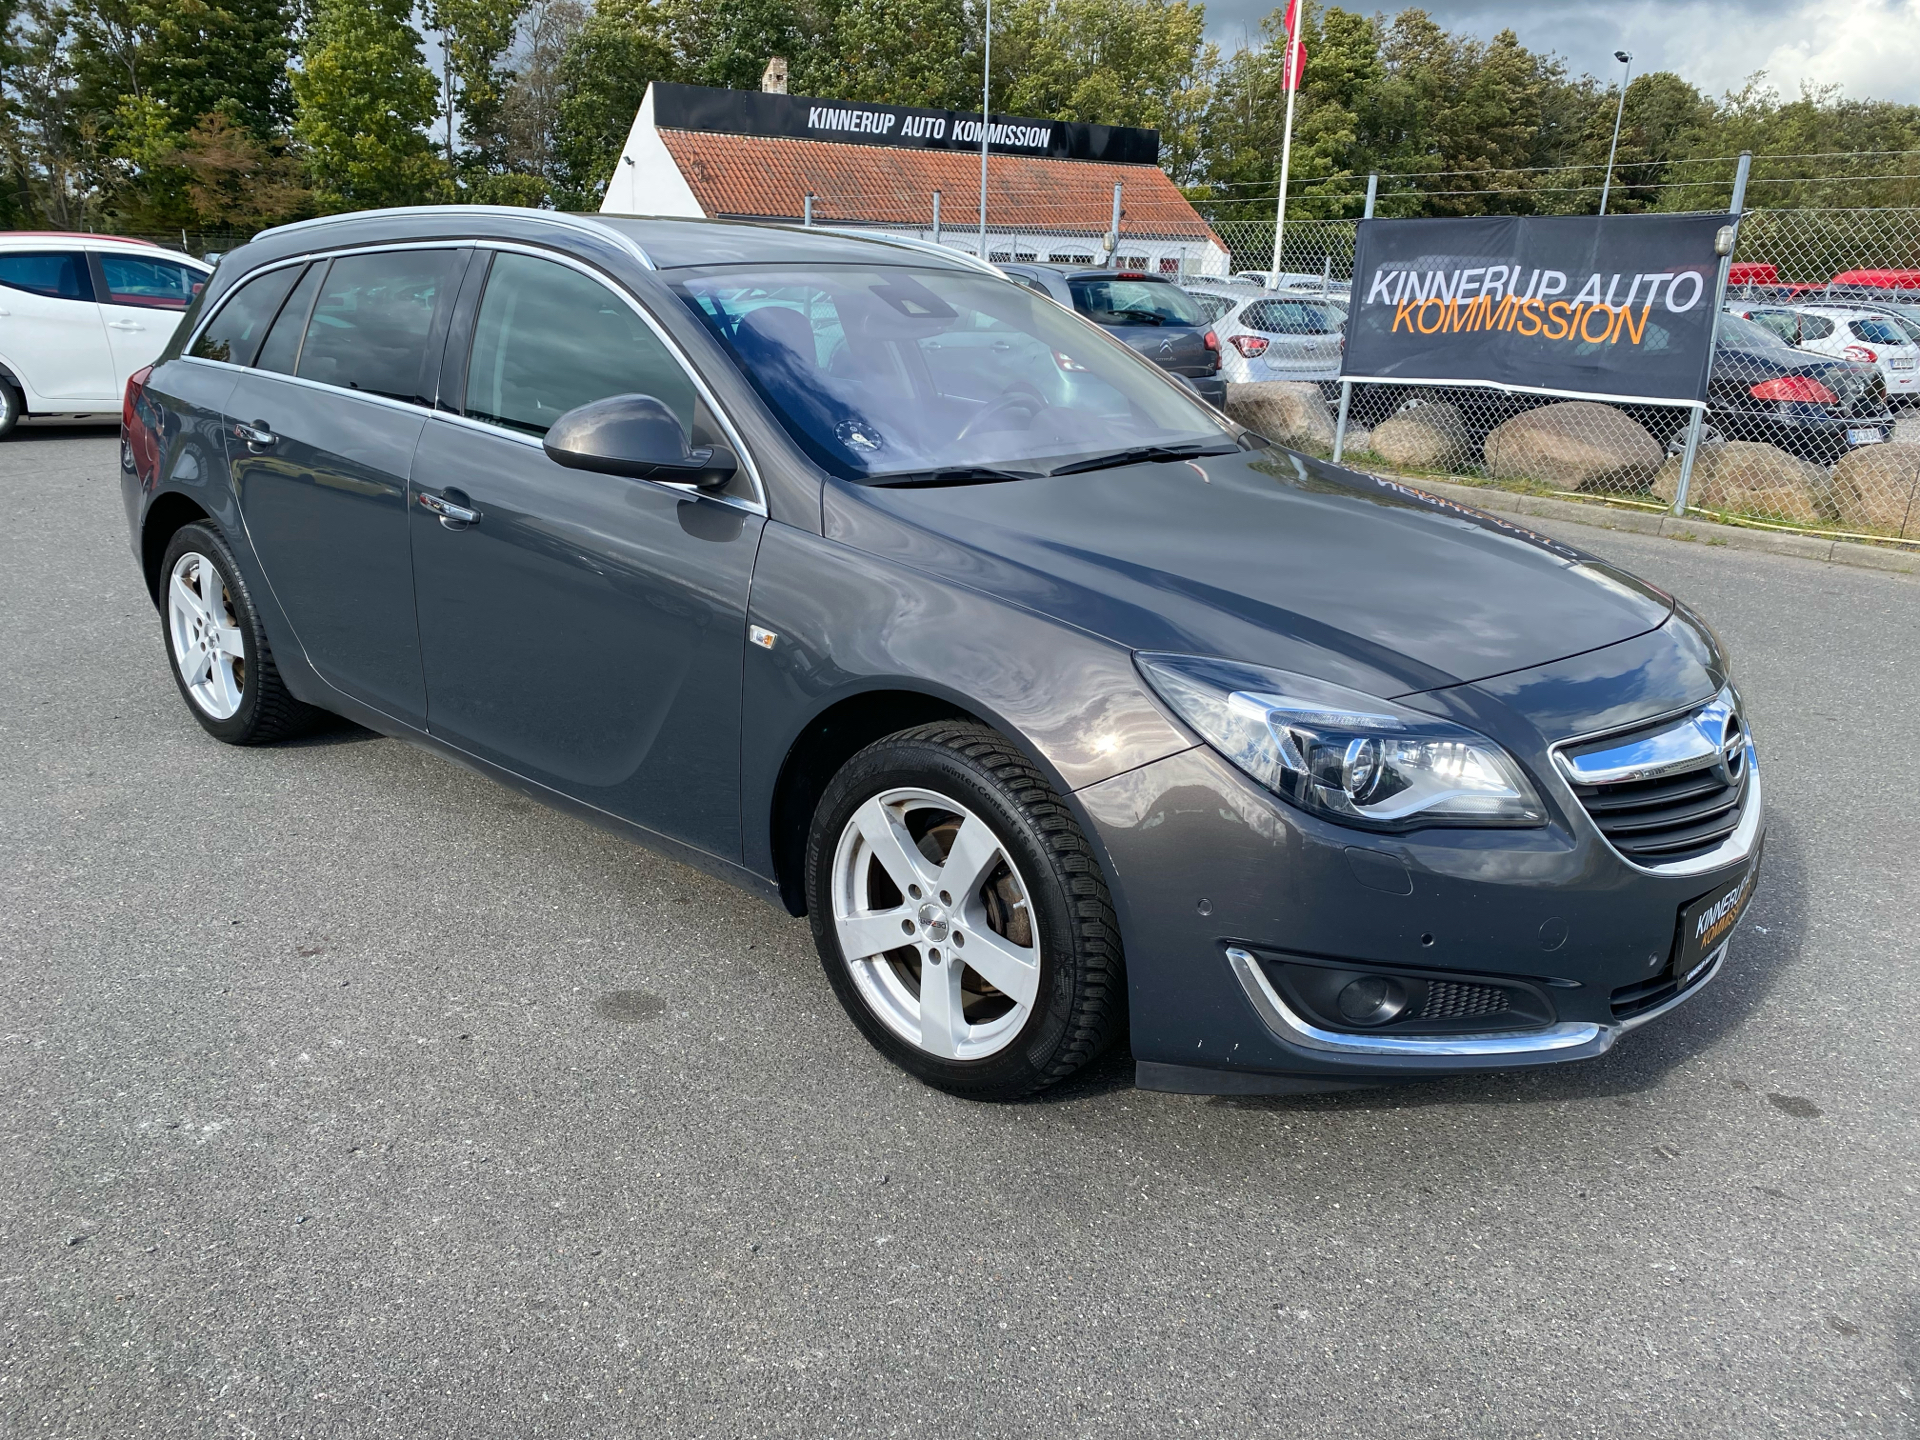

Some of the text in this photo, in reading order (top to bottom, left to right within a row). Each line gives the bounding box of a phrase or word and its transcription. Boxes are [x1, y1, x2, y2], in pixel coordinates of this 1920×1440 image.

[808, 107, 1051, 148] KINNERUP AUTO KOMMISSION
[1366, 265, 1704, 313] KINNERUP AUTO
[1391, 294, 1650, 345] KOMMISSION
[808, 843, 824, 936] Continental
